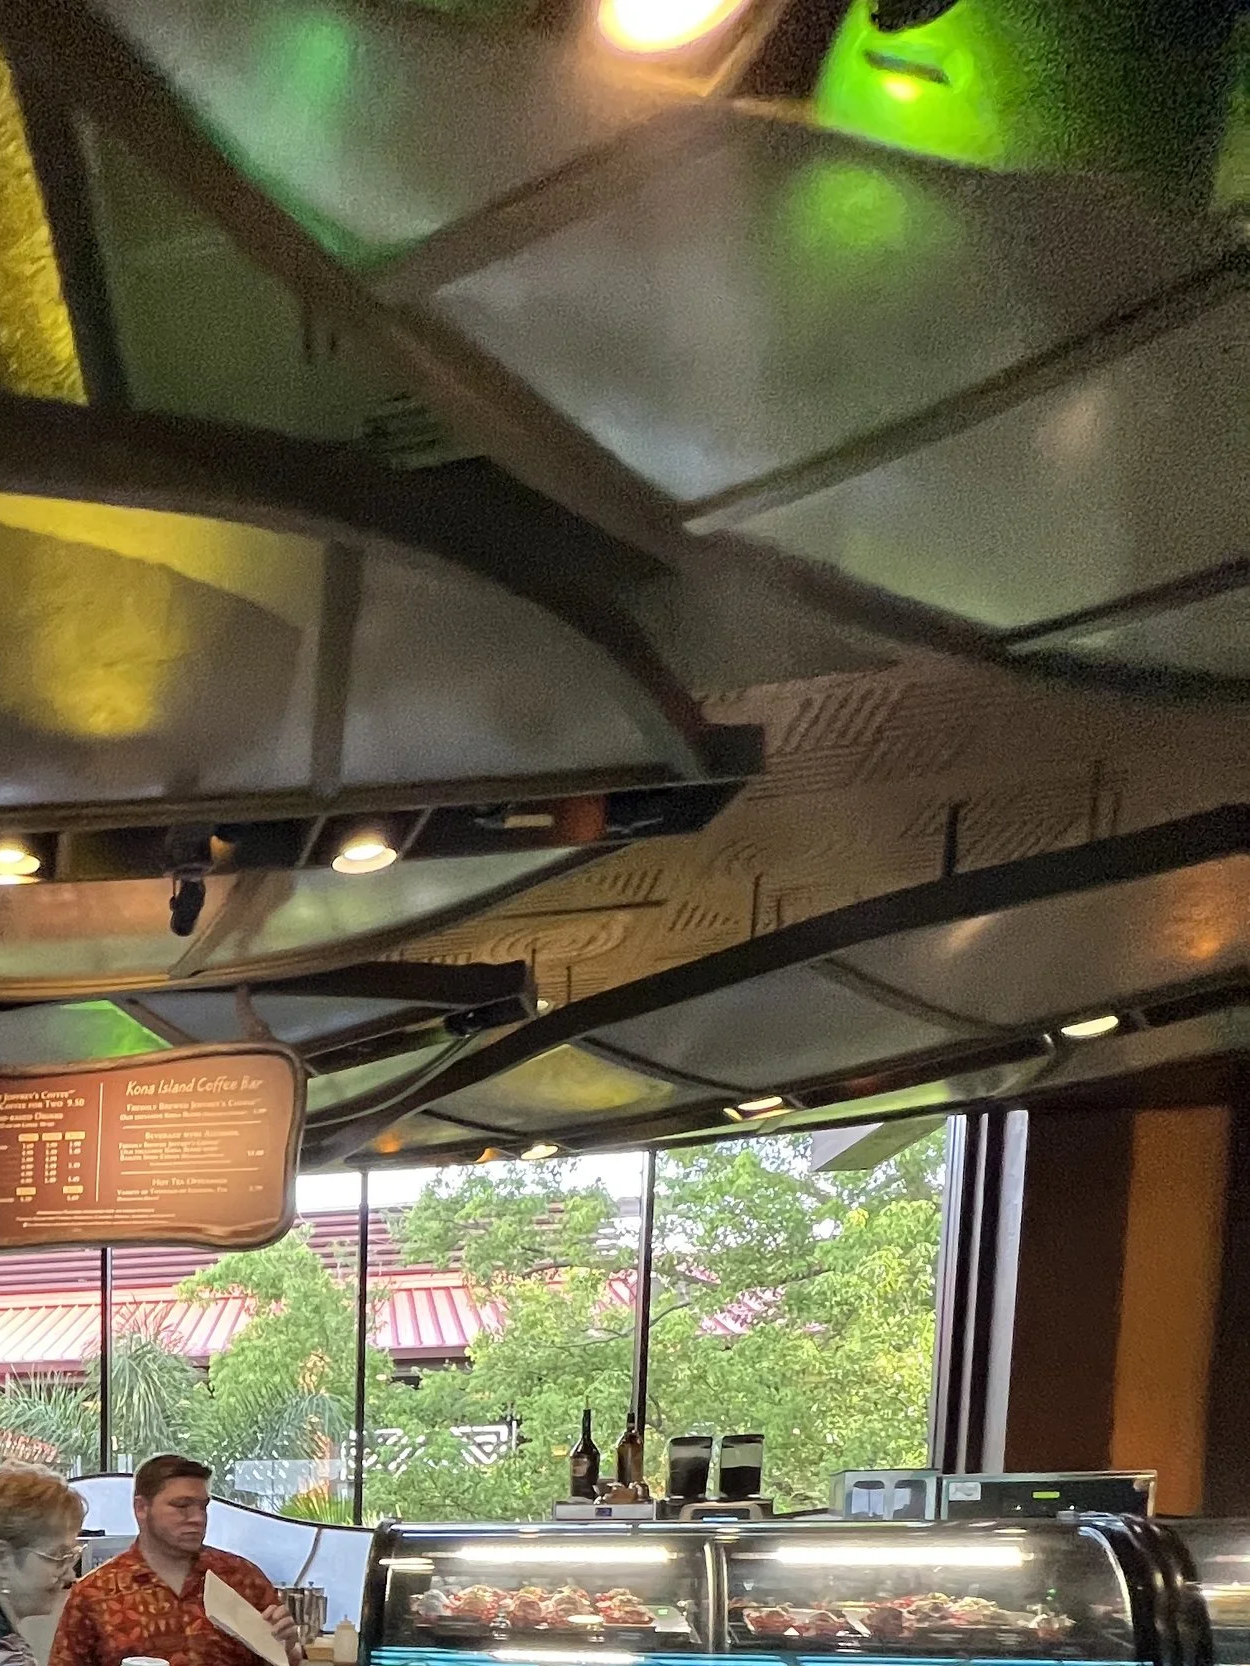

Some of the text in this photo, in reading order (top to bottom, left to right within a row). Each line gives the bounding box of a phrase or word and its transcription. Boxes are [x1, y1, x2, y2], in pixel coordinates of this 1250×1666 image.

[126, 1075, 264, 1096] Kona Island Coffee Bar
[45, 1099, 64, 1109] TWO
